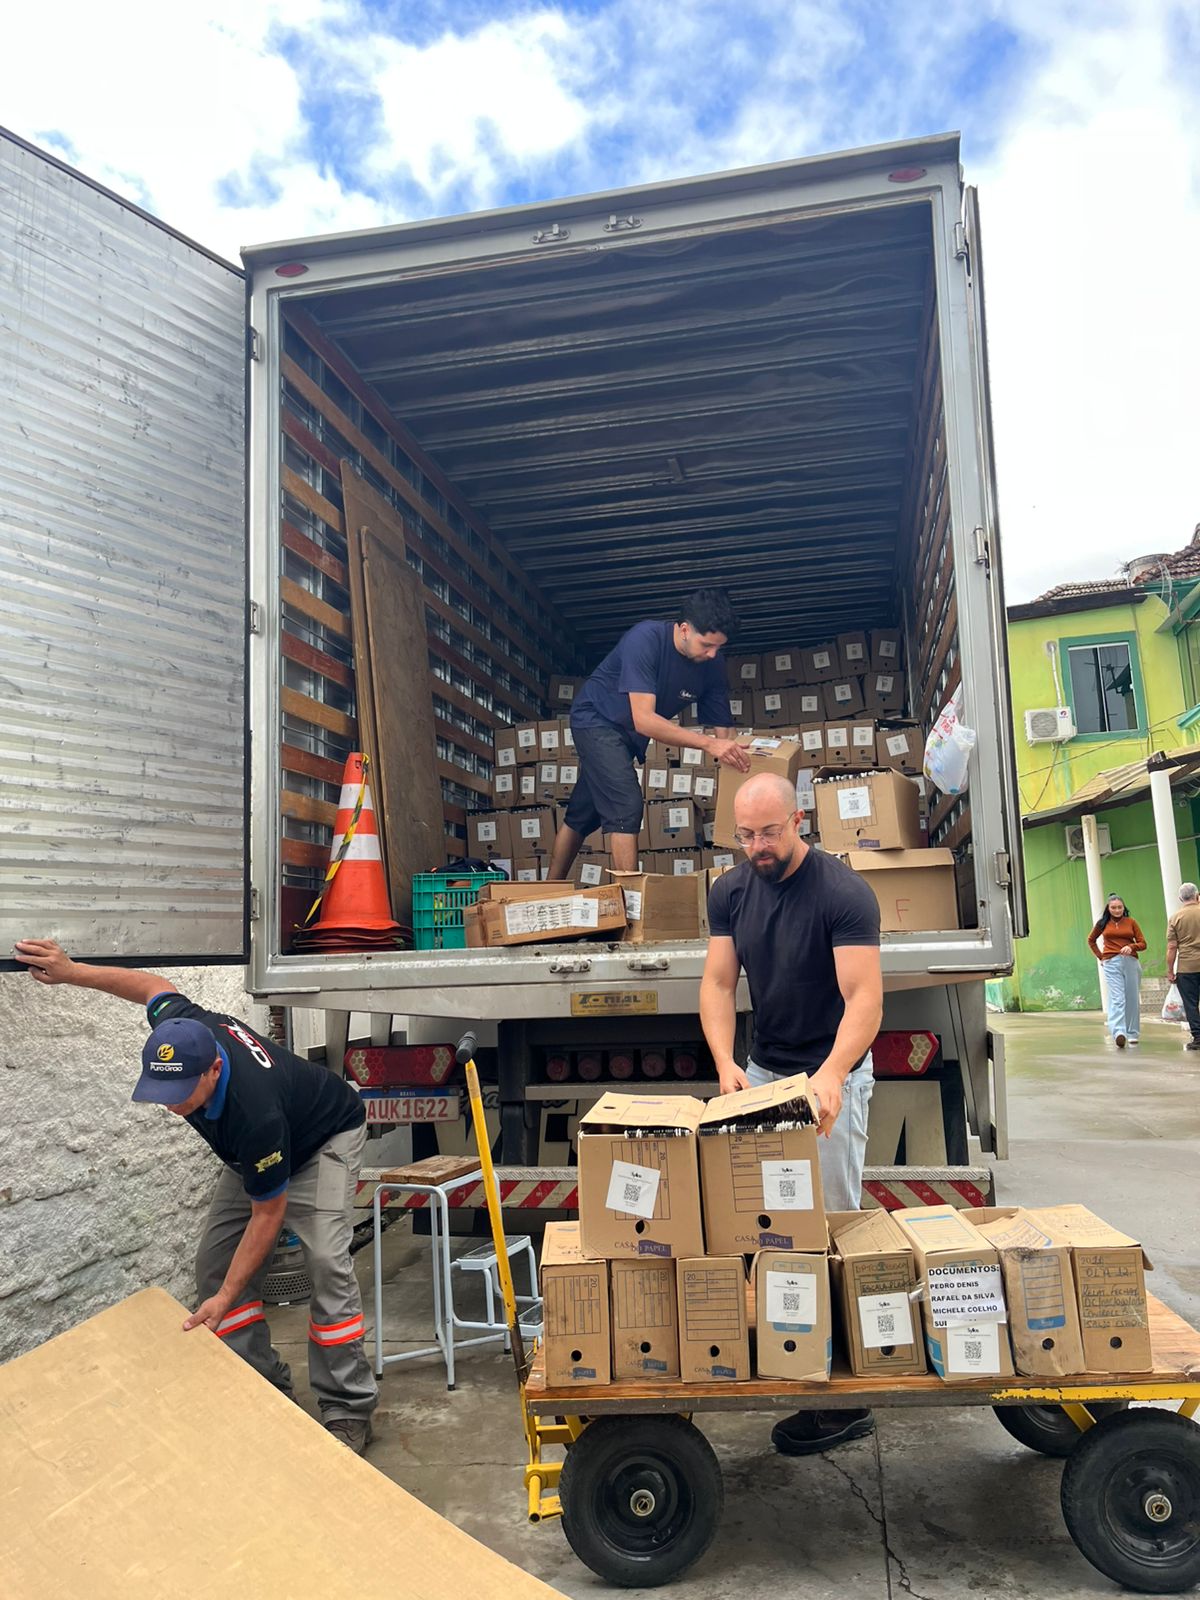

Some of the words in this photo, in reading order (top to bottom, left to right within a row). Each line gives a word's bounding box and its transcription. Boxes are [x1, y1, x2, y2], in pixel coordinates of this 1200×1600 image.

[896, 898, 911, 922] F
[367, 1098, 448, 1120] AUK1G22
[765, 1237, 788, 1245] PAPEL
[928, 1265, 1000, 1276] DOCUMENTOS:
[687, 1273, 696, 1281] 20
[973, 1292, 995, 1300] SILVA
[967, 1305, 998, 1313] COELHO
